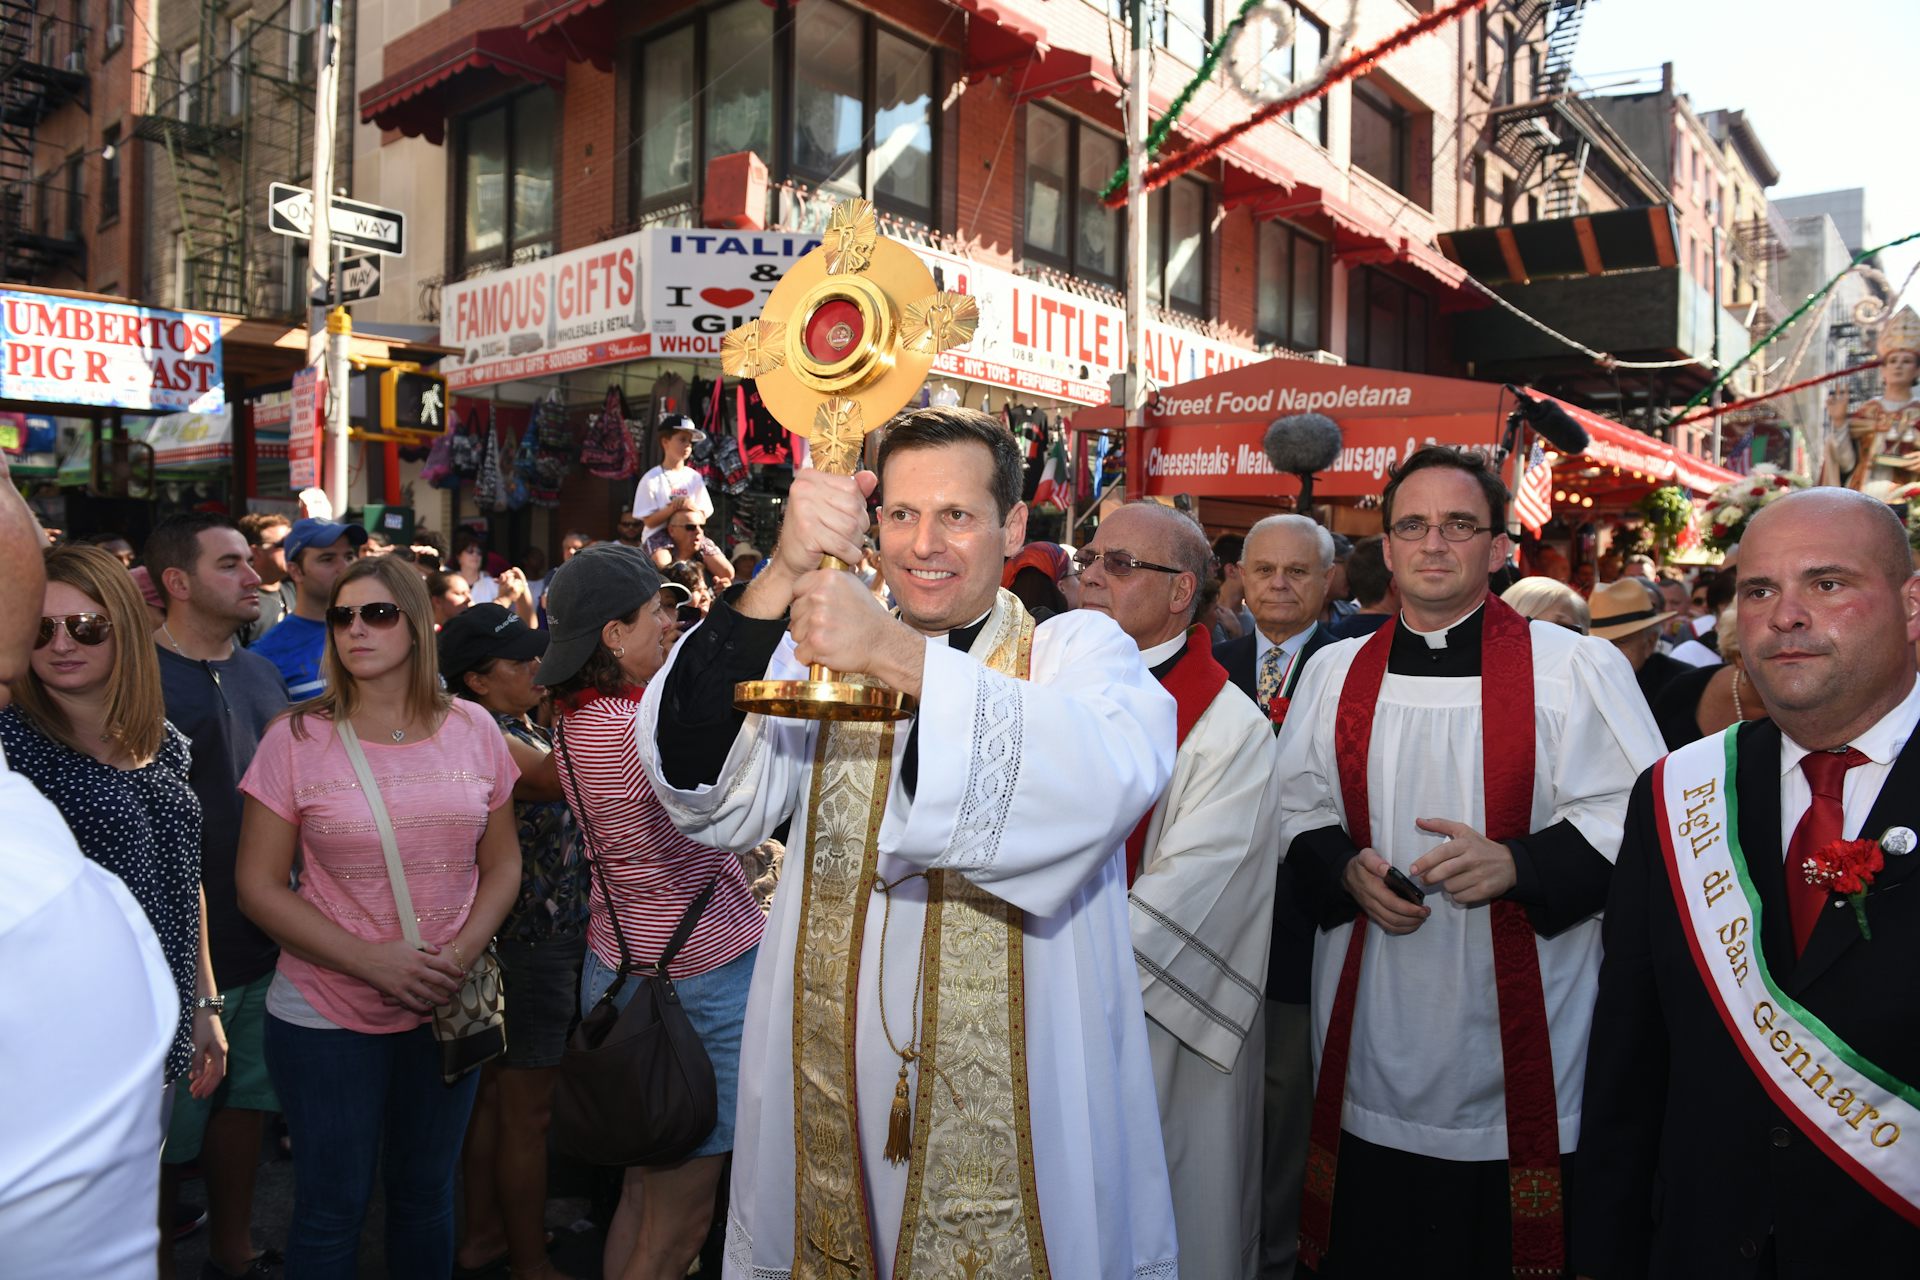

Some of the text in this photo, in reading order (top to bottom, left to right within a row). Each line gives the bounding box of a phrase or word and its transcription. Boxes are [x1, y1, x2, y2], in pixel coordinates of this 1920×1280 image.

[287, 203, 392, 239] ON WAY
[671, 235, 824, 257] ITALIA
[349, 268, 371, 287] WAY
[750, 264, 783, 282] &
[456, 247, 635, 343] FAMOUS GIFTS
[666, 286, 692, 307] I
[6, 300, 212, 355] UMBERTOS
[557, 320, 598, 342] WHOLESALE
[607, 314, 632, 332] RETAIL
[659, 335, 726, 353] WHOL
[1012, 287, 1109, 368] LITTLE
[1118, 320, 1184, 385] IALY
[6, 342, 215, 393] PIG RAST
[526, 356, 545, 373] GIFTS
[549, 347, 588, 369] SOUVENIRS
[932, 353, 1105, 404] AGE NYC TOYS PERFUMES WATCHES
[1152, 385, 1412, 417] Street Food Napoletana
[1148, 445, 1230, 477] Cheesesteaks
[1236, 444, 1280, 475] Meat
[1324, 446, 1397, 481] ausage
[1677, 777, 1902, 1149] Figli di San Gennaro
